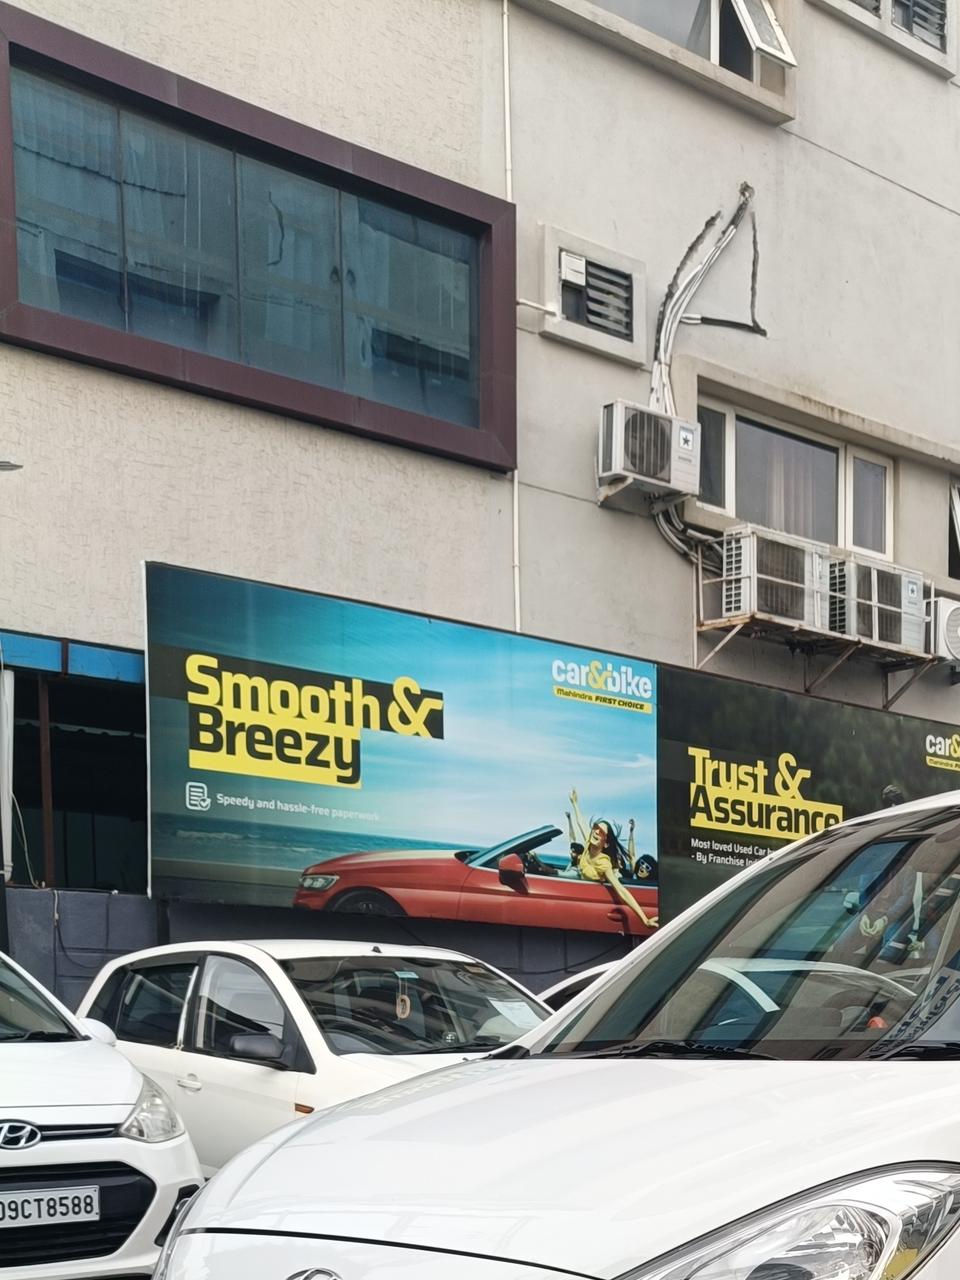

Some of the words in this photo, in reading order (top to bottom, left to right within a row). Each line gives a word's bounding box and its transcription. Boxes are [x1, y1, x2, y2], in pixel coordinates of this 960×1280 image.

[185, 653, 381, 731] Smooth
[387, 676, 443, 738] &
[552, 659, 652, 699] car&bike
[595, 695, 617, 705] FIRST
[617, 699, 645, 710] CHOICE
[189, 704, 361, 784] Breezy
[687, 746, 769, 794] Trust
[774, 752, 812, 800] &
[216, 793, 255, 810] Speedy
[256, 799, 275, 810] and
[277, 801, 330, 817] hassle-free
[331, 808, 380, 821] paperwork
[690, 784, 840, 835] Assurance
[690, 838, 711, 849] Most
[711, 840, 733, 852] loved
[734, 842, 753, 854] Used
[753, 846, 767, 856] Car
[696, 852, 707, 864] By
[708, 853, 745, 867] Franchise
